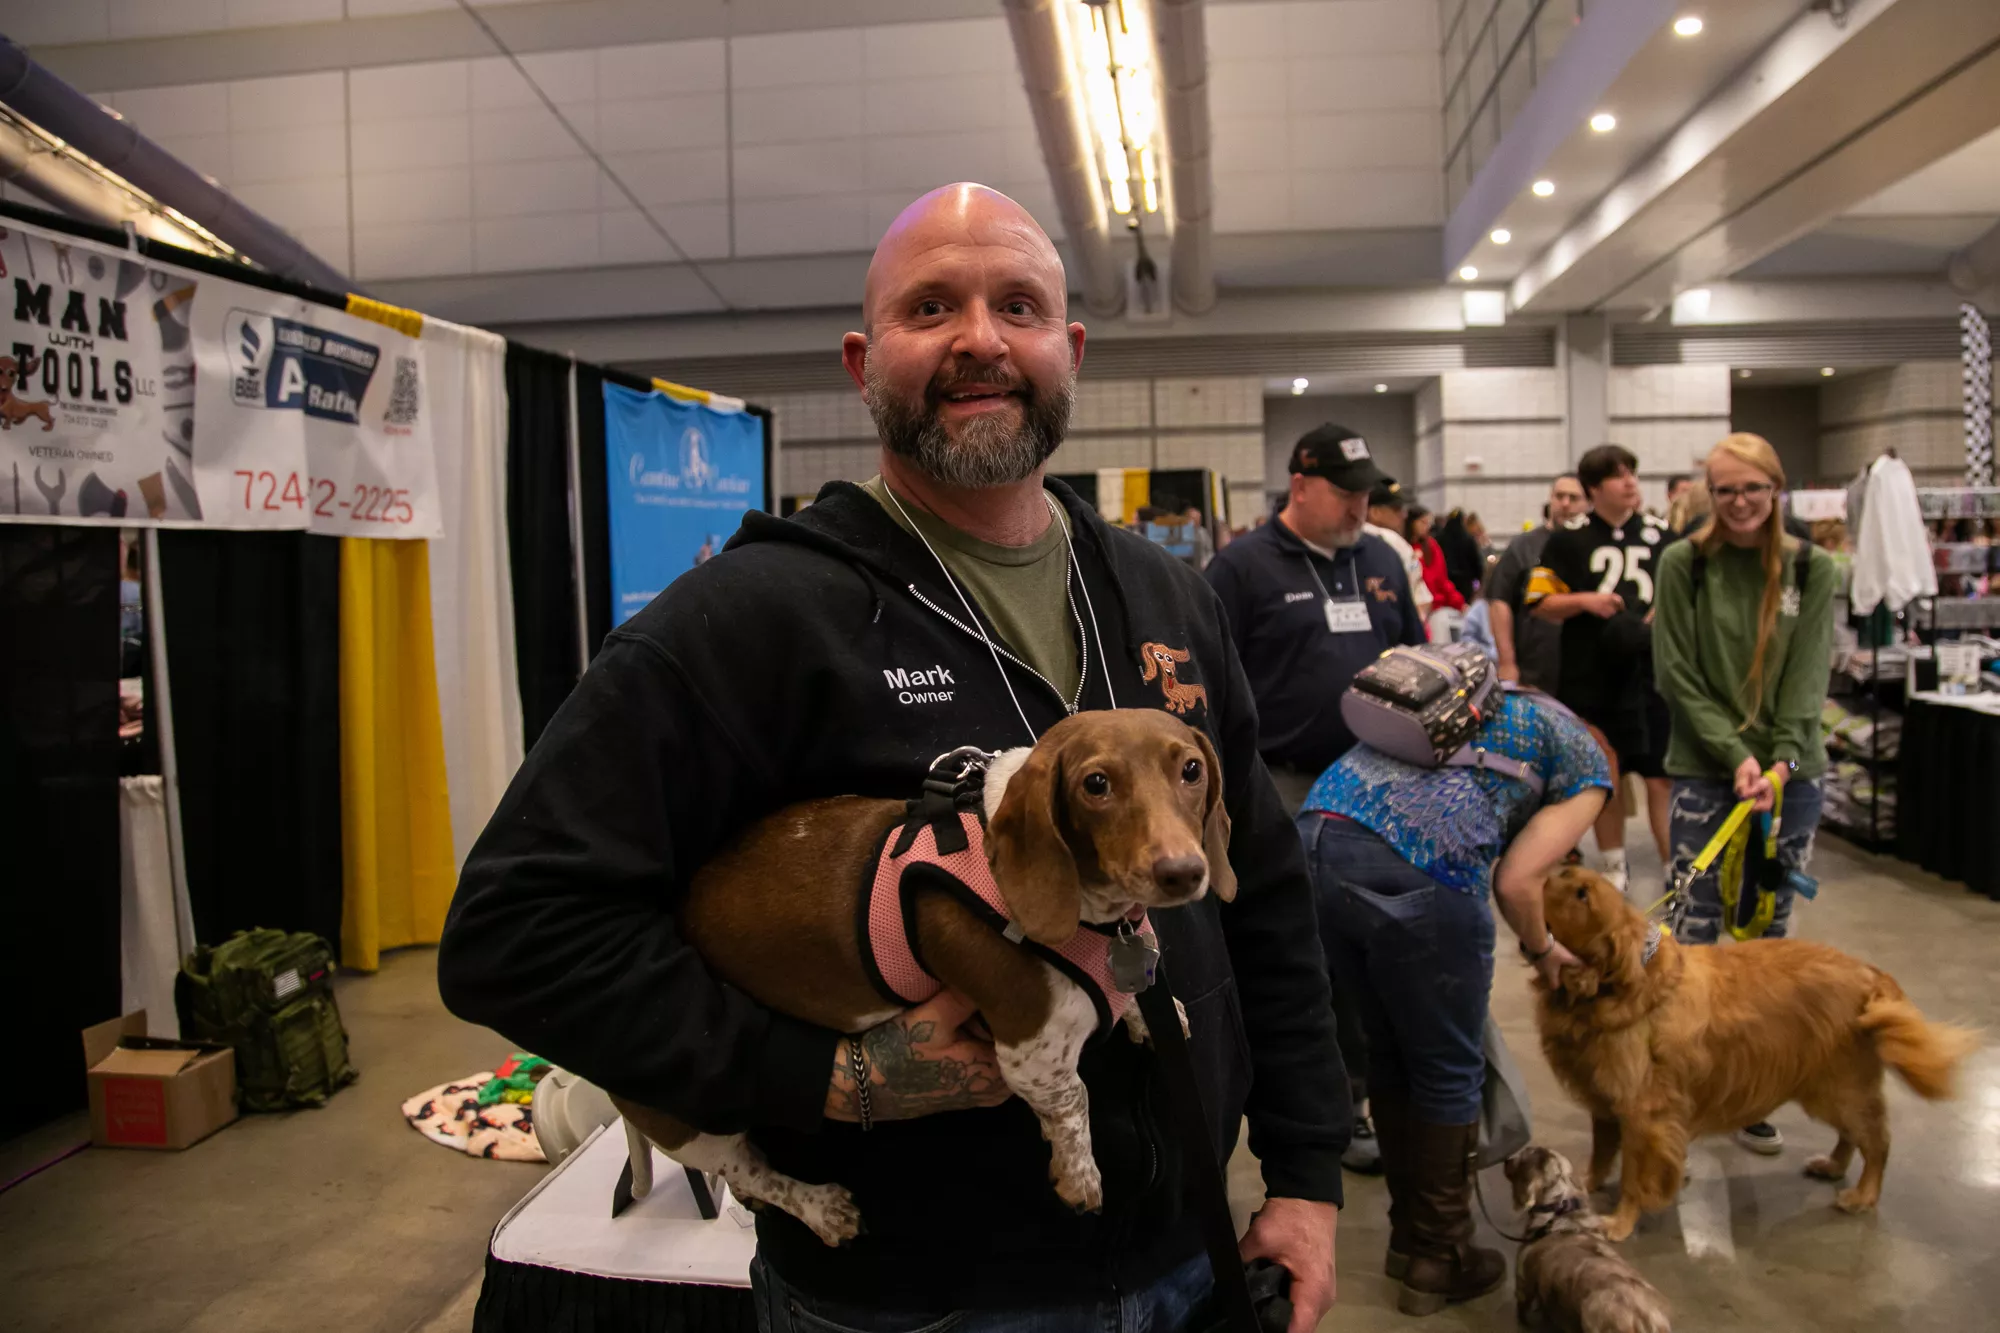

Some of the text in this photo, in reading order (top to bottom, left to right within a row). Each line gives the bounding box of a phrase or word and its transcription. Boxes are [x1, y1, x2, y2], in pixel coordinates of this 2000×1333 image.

[14, 276, 128, 341] MAN
[48, 332, 94, 351] WITH
[12, 342, 156, 404] TOOLS LLC
[28, 445, 75, 459] VETERAN
[1589, 545, 1654, 605] 25
[883, 664, 956, 690] Mark
[898, 691, 955, 705] Owner
